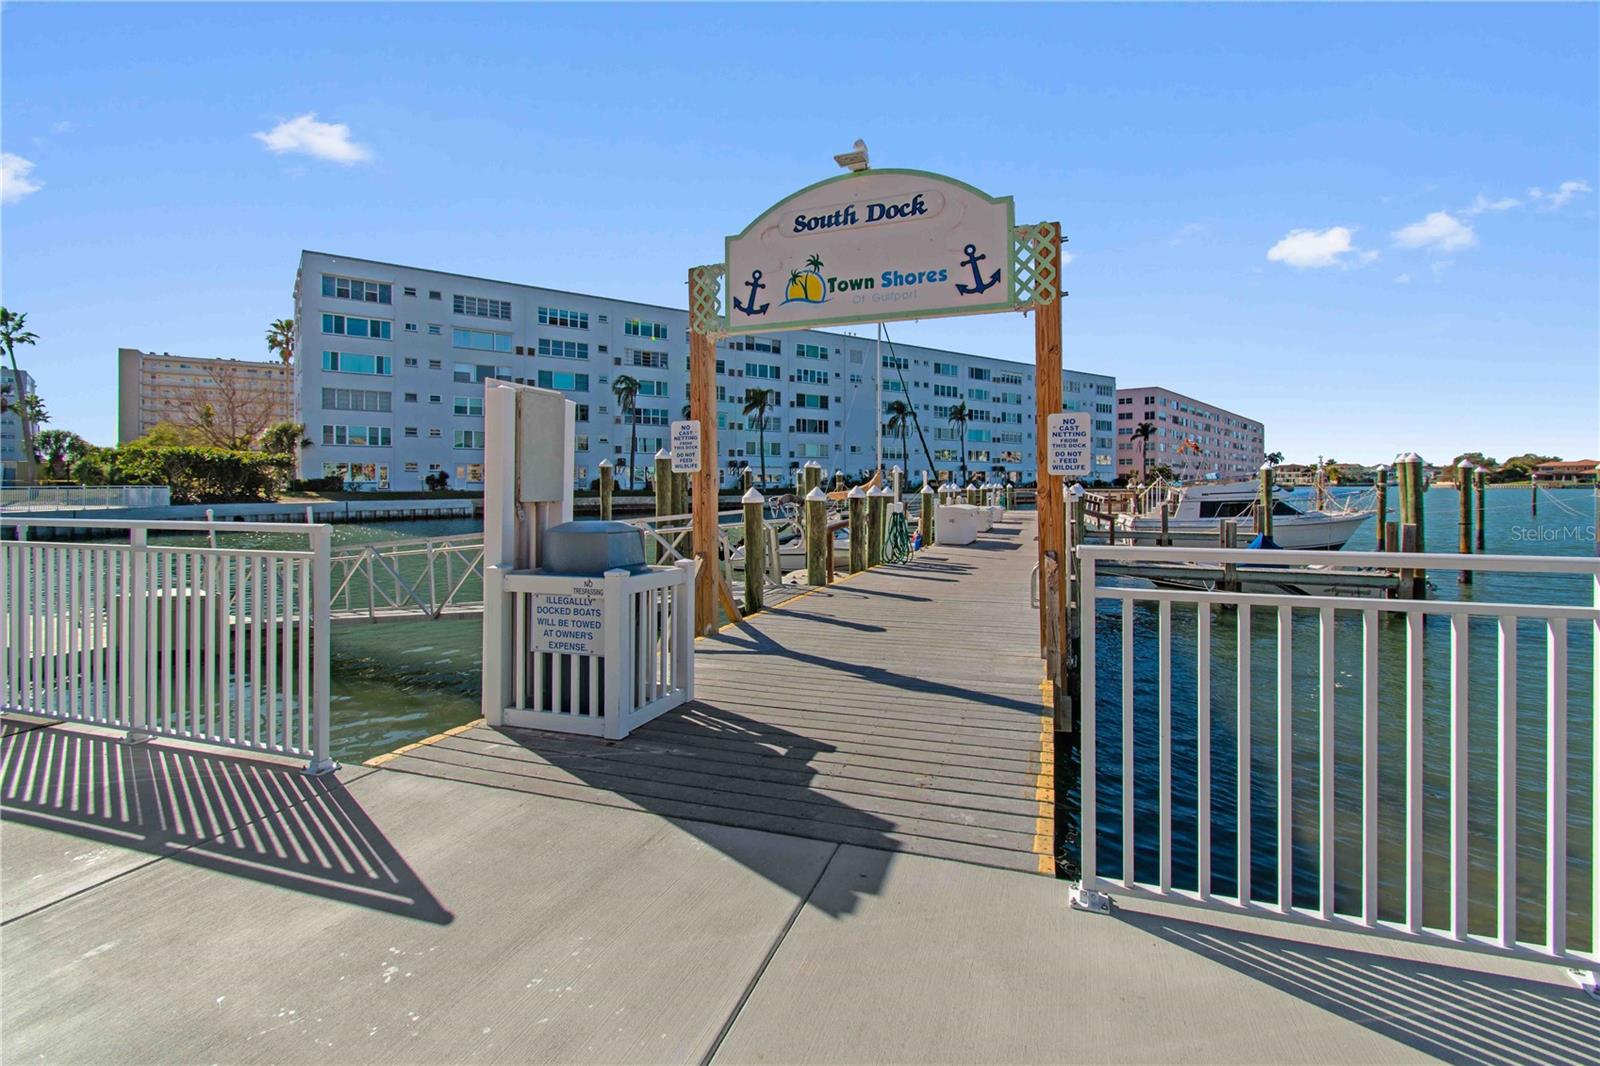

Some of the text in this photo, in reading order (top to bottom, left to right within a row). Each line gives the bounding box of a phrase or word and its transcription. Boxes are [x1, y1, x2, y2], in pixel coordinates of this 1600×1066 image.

[793, 194, 928, 233] South Dock
[827, 268, 948, 293] Town Shores
[583, 580, 593, 588] NO
[573, 587, 604, 596] TRESPASSING
[536, 606, 602, 618] DOCKED BOATS
[537, 617, 602, 630] WILL BE TOWED
[543, 629, 593, 641] AT OWNER'S
